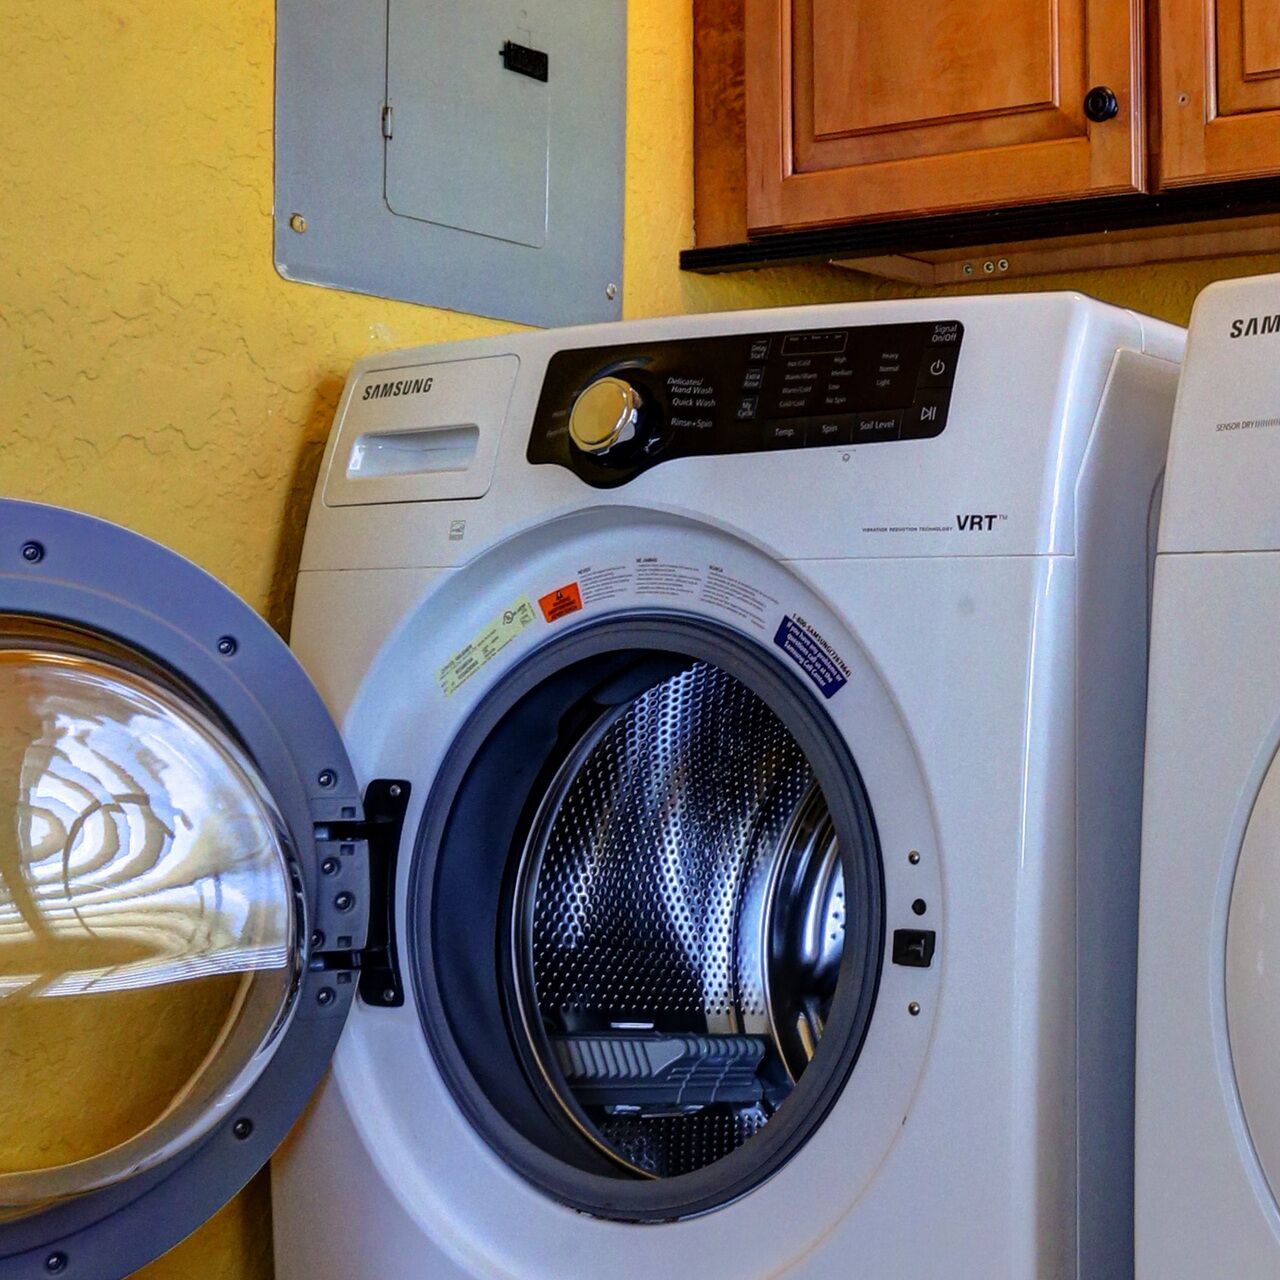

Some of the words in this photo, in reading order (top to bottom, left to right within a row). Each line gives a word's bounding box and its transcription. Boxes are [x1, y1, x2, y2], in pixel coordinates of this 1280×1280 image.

[935, 324, 957, 334] Signal
[932, 333, 957, 342] On/Off
[363, 378, 433, 400] SAMSUNG
[671, 386, 691, 394] Hand
[693, 386, 713, 394] Wash
[672, 398, 694, 407] Quick
[696, 398, 716, 407] Wash
[822, 424, 838, 434] Spin
[860, 421, 874, 431] Soil
[875, 420, 895, 429] Level
[1216, 422, 1241, 432] SENSOR
[1241, 420, 1255, 430] DRY
